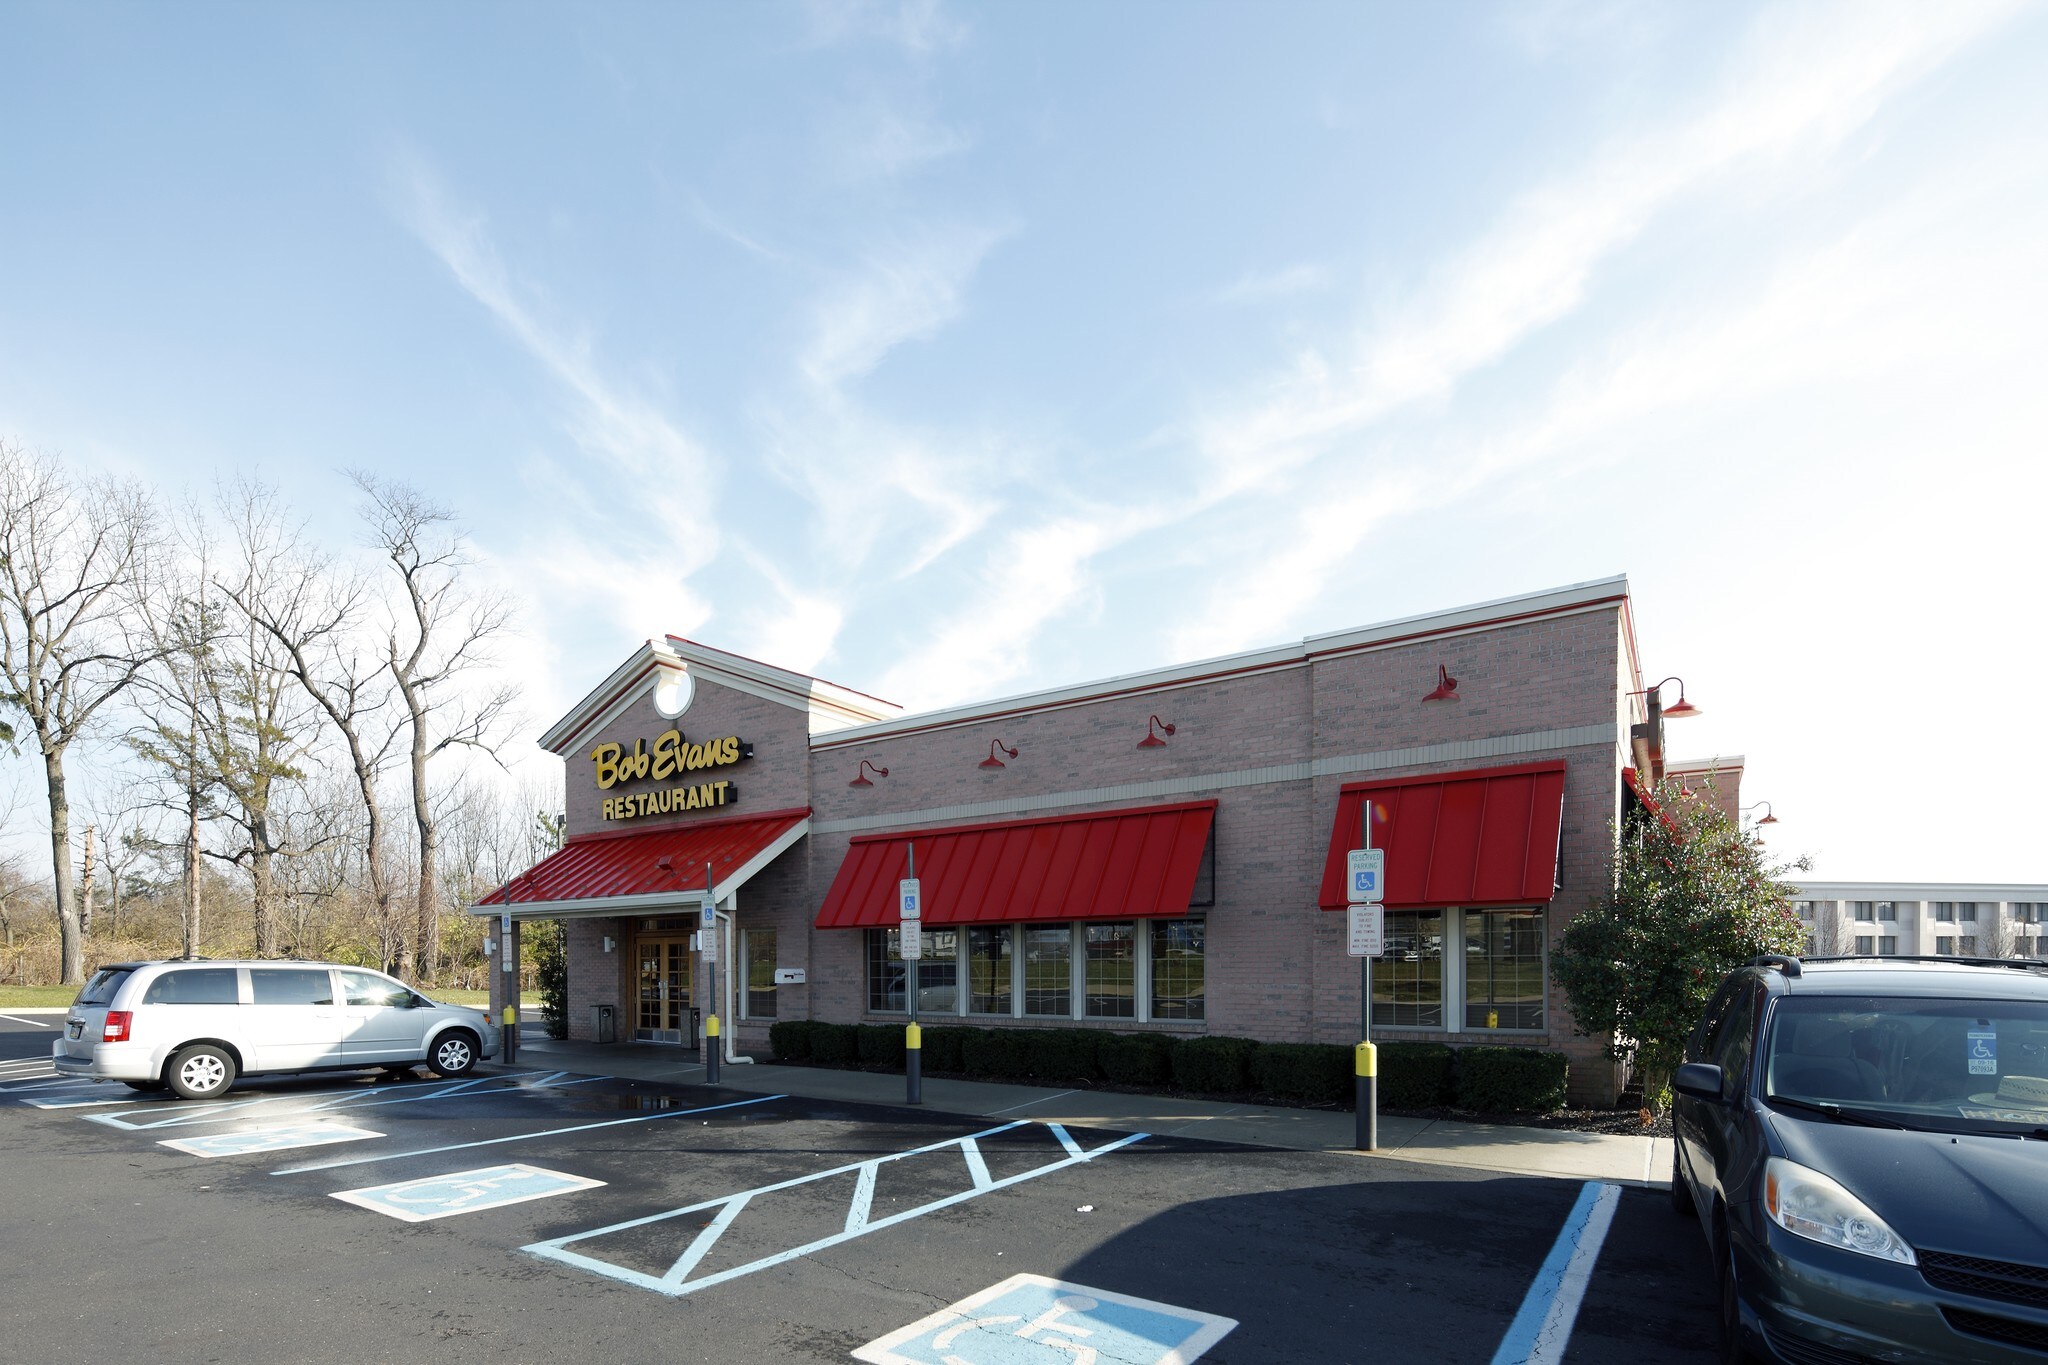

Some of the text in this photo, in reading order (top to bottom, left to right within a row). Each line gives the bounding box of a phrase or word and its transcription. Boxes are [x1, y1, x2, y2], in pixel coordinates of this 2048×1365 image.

[591, 728, 741, 790] Bob Evans
[602, 780, 732, 821] RESTAURANT
[1351, 853, 1381, 862] RESERVED
[1353, 861, 1378, 870] PARKING
